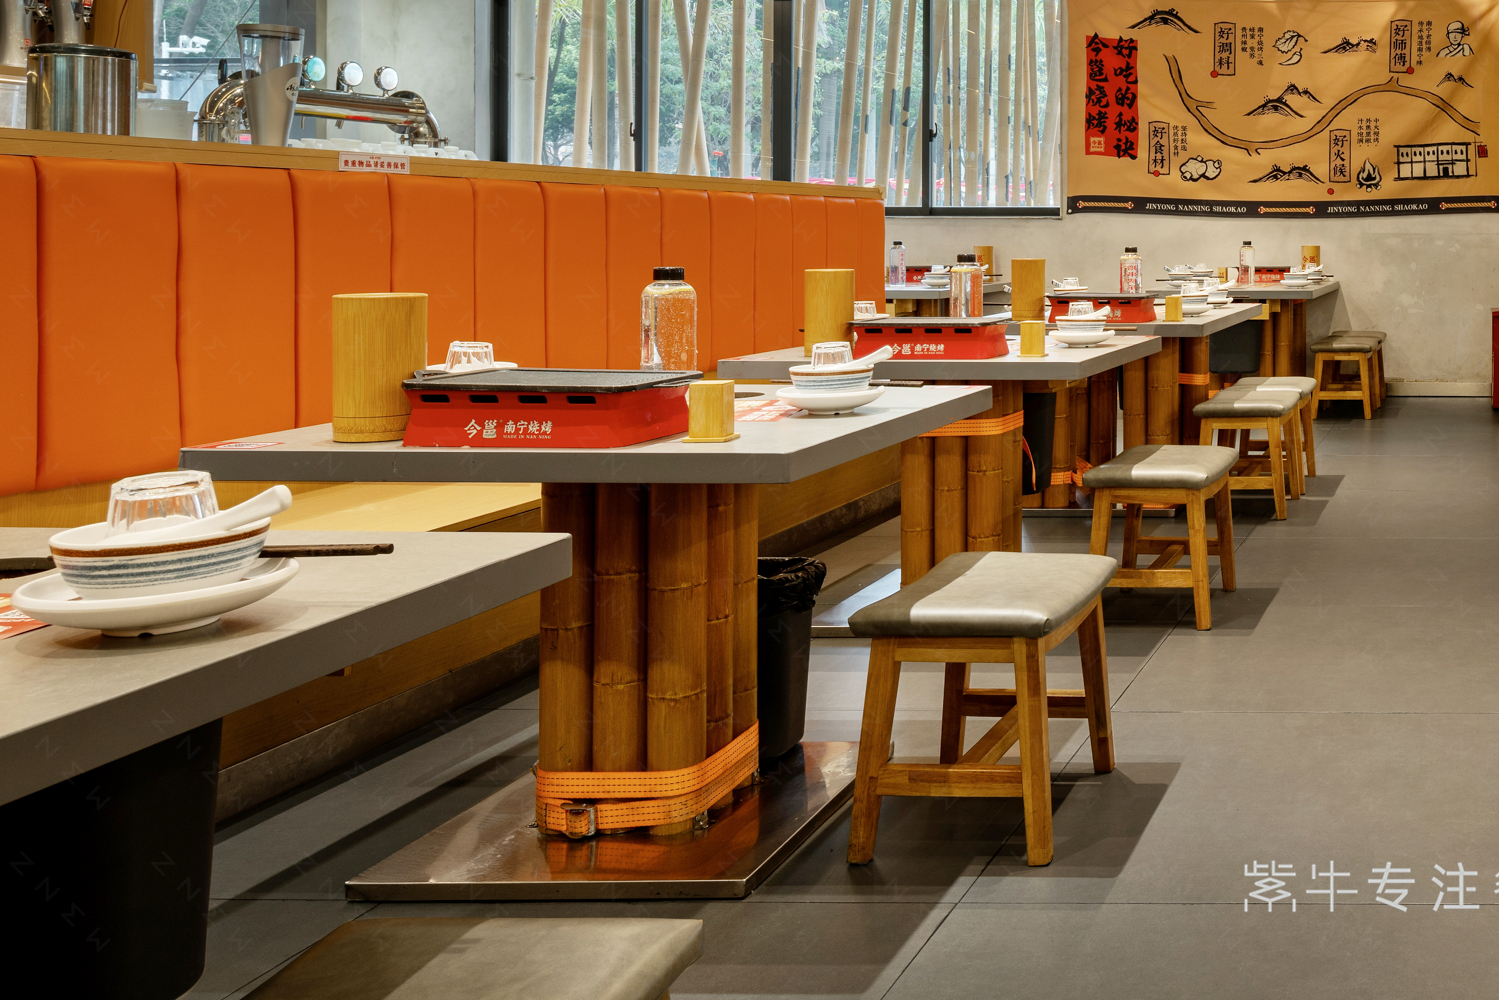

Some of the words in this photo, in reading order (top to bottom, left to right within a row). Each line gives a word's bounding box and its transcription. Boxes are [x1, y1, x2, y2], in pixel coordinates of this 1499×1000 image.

[1216, 26, 1234, 70] 好调料
[1392, 23, 1410, 67] 好师傅
[1085, 32, 1110, 135] 今邕烧烤
[1112, 35, 1139, 161] 好吃的秘诀
[343, 159, 407, 170] 贵重物品请妥善保管
[1151, 125, 1167, 169] 好食材
[1332, 134, 1348, 178] 好火候
[1145, 203, 1176, 211] JINYONG
[1178, 204, 1211, 212] NANNING
[1212, 205, 1247, 213] SHAOKAO
[1360, 204, 1392, 212] NANNING
[1393, 203, 1428, 211] SHAOKAO
[914, 343, 945, 351] 南宁烧烤
[464, 418, 497, 439] 今邕
[503, 419, 553, 434] 南宁烧烤
